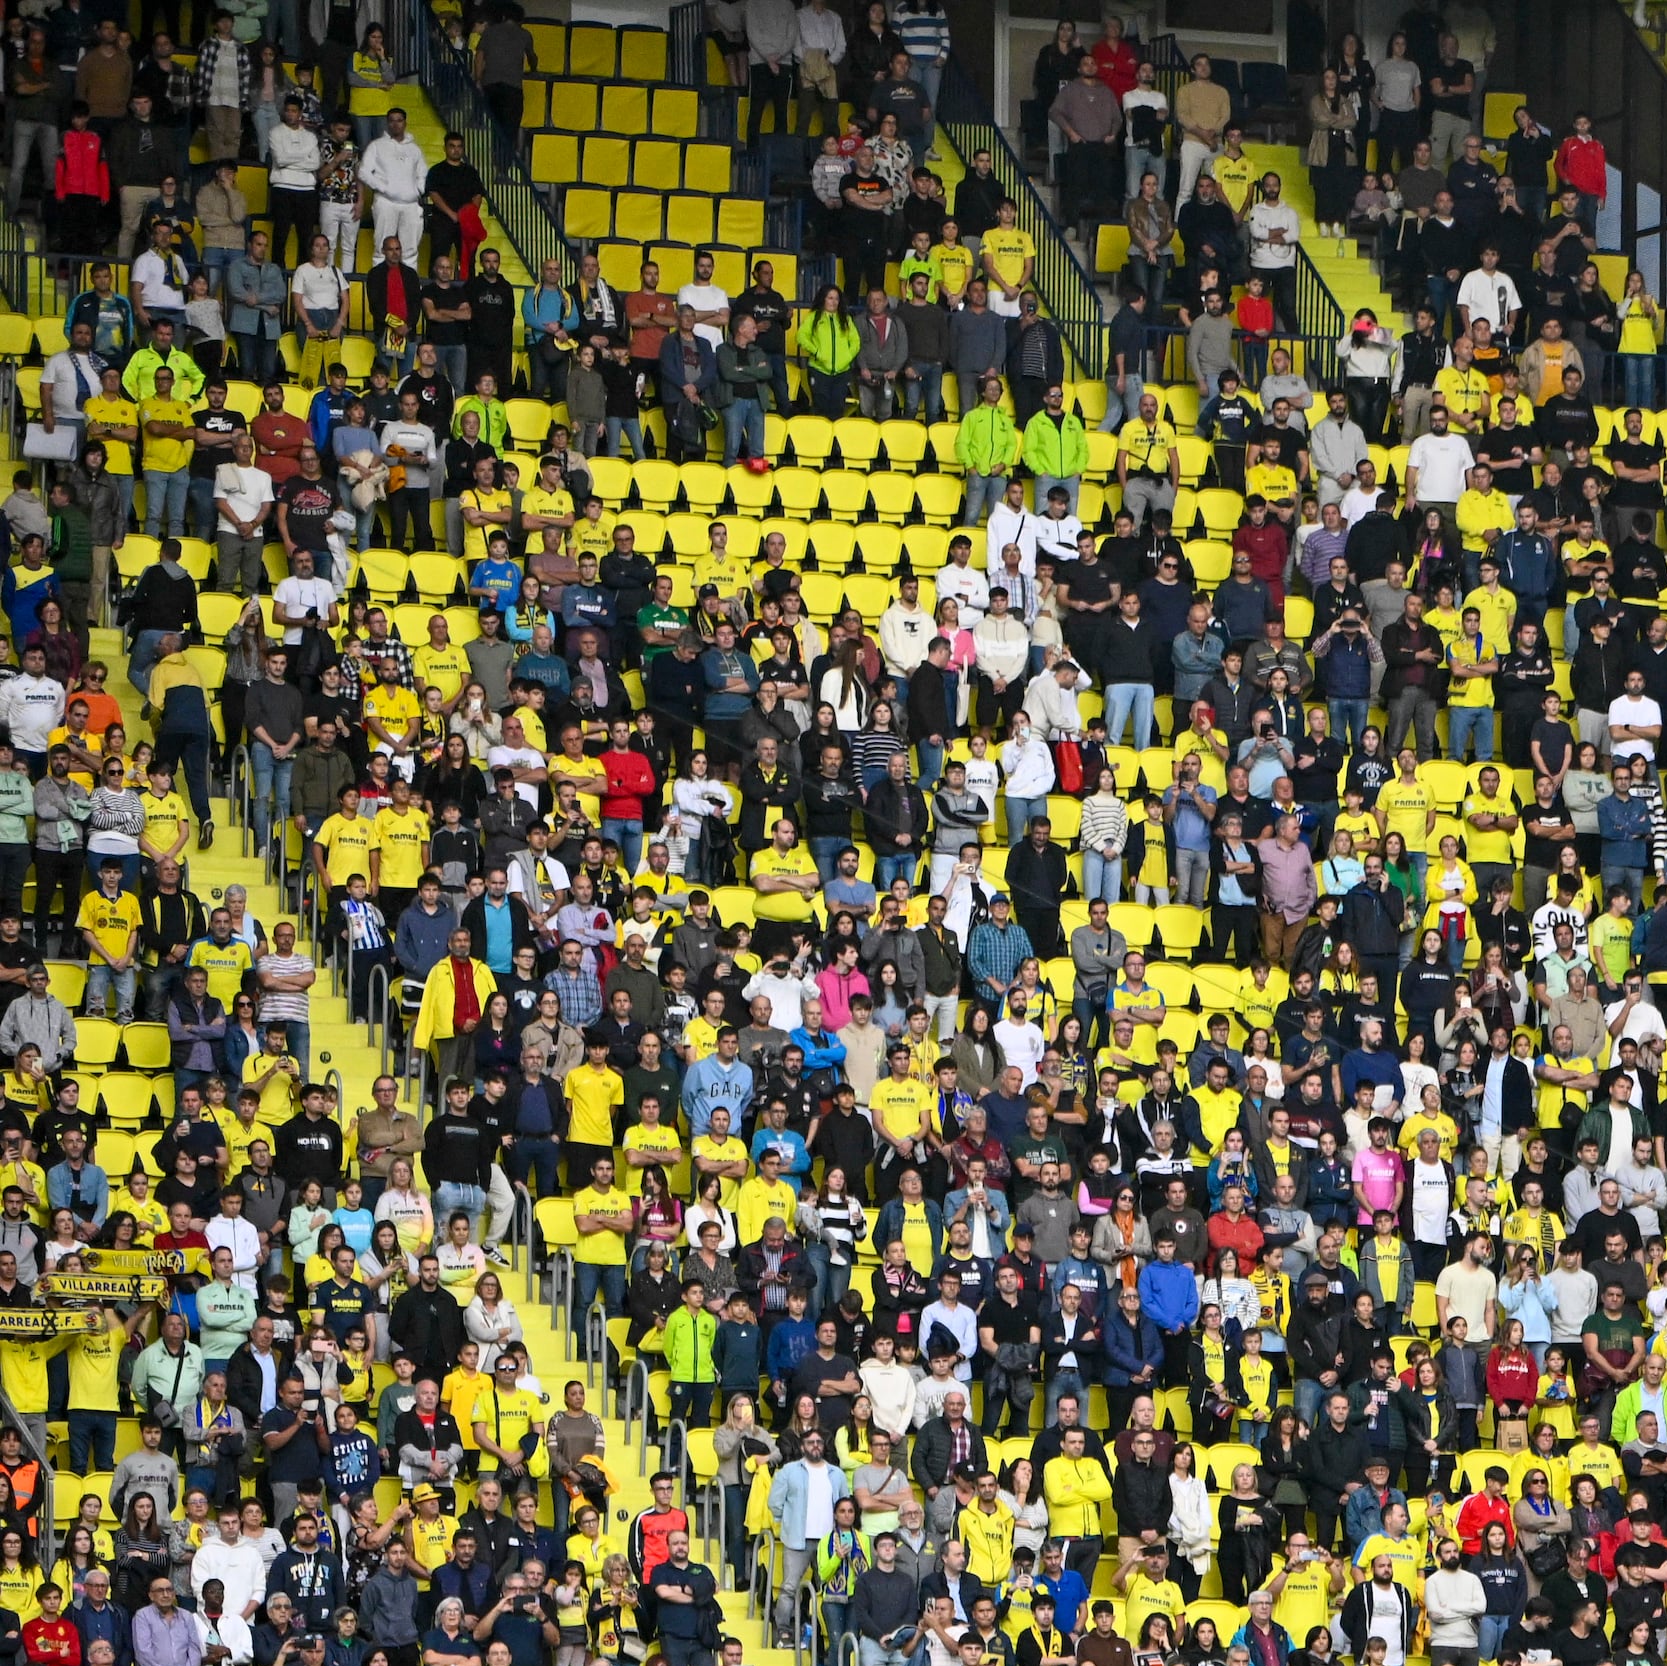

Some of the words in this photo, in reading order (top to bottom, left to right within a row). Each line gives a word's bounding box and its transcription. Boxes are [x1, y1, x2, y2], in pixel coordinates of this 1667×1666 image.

[291, 507, 329, 517] CLASSICS
[710, 1081, 741, 1099] GAP
[60, 1280, 135, 1294] VILLARREAL
